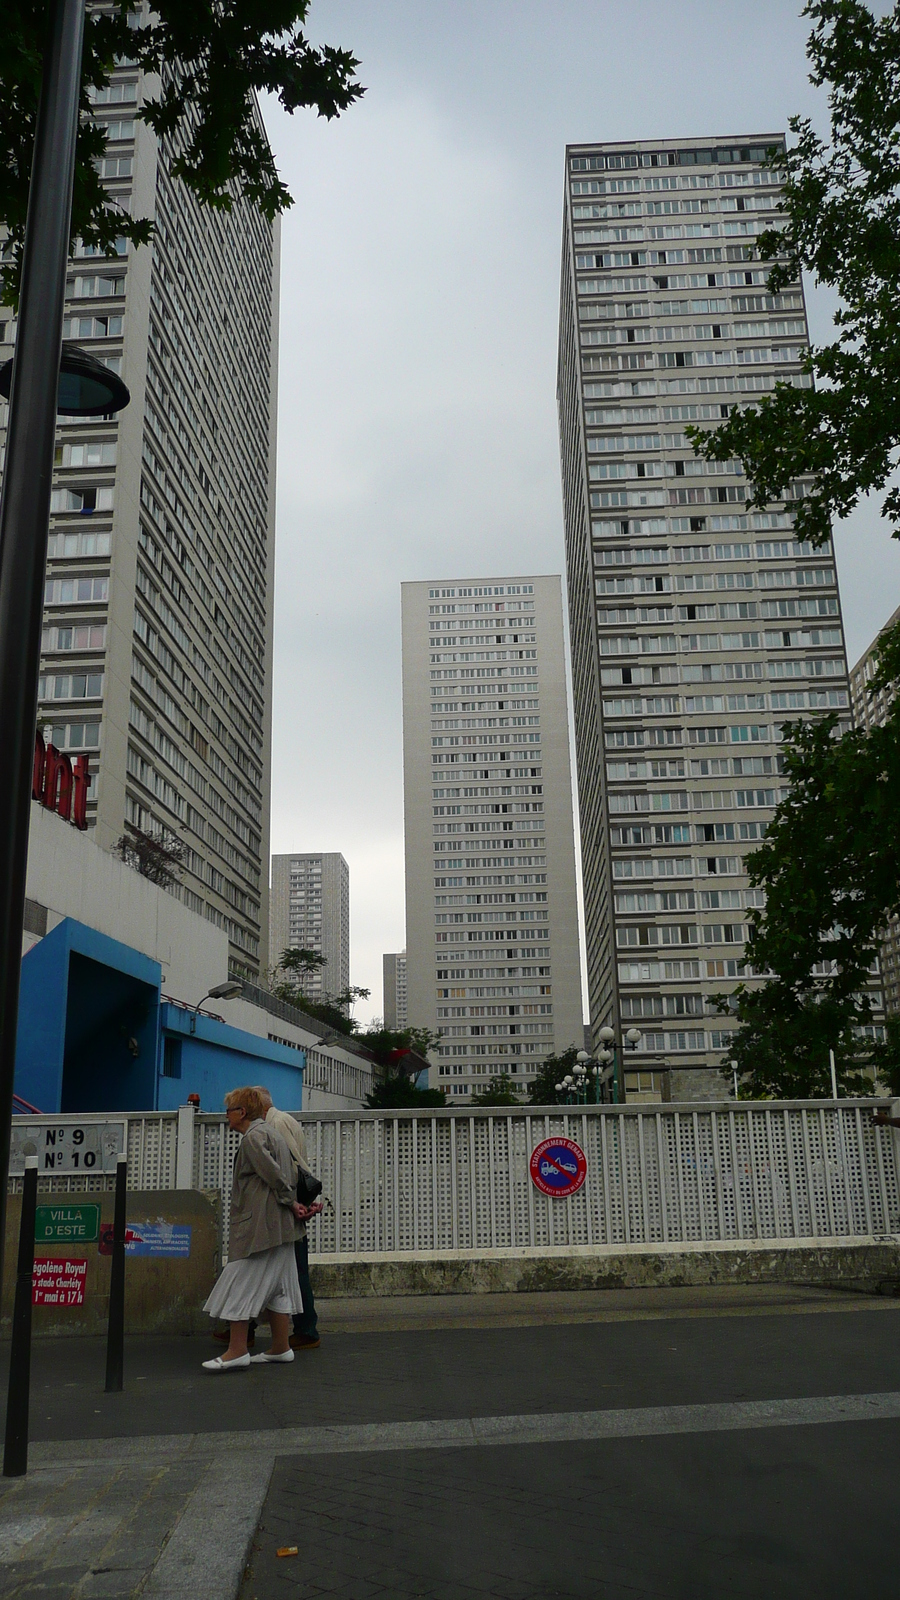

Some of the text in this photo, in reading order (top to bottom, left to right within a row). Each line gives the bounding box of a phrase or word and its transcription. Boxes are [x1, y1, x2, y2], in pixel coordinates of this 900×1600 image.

[72, 1129, 84, 1145] 9
[71, 1151, 96, 1168] 10
[532, 1139, 566, 1168] STATIONNEMENT
[50, 1210, 82, 1221] VILLA
[45, 1225, 86, 1236] D'ESTE
[33, 1260, 86, 1277] égolène Royal
[37, 1276, 55, 1287] stade
[56, 1276, 82, 1291] Charléty
[44, 1290, 59, 1303] mai
[59, 1290, 65, 1303] à
